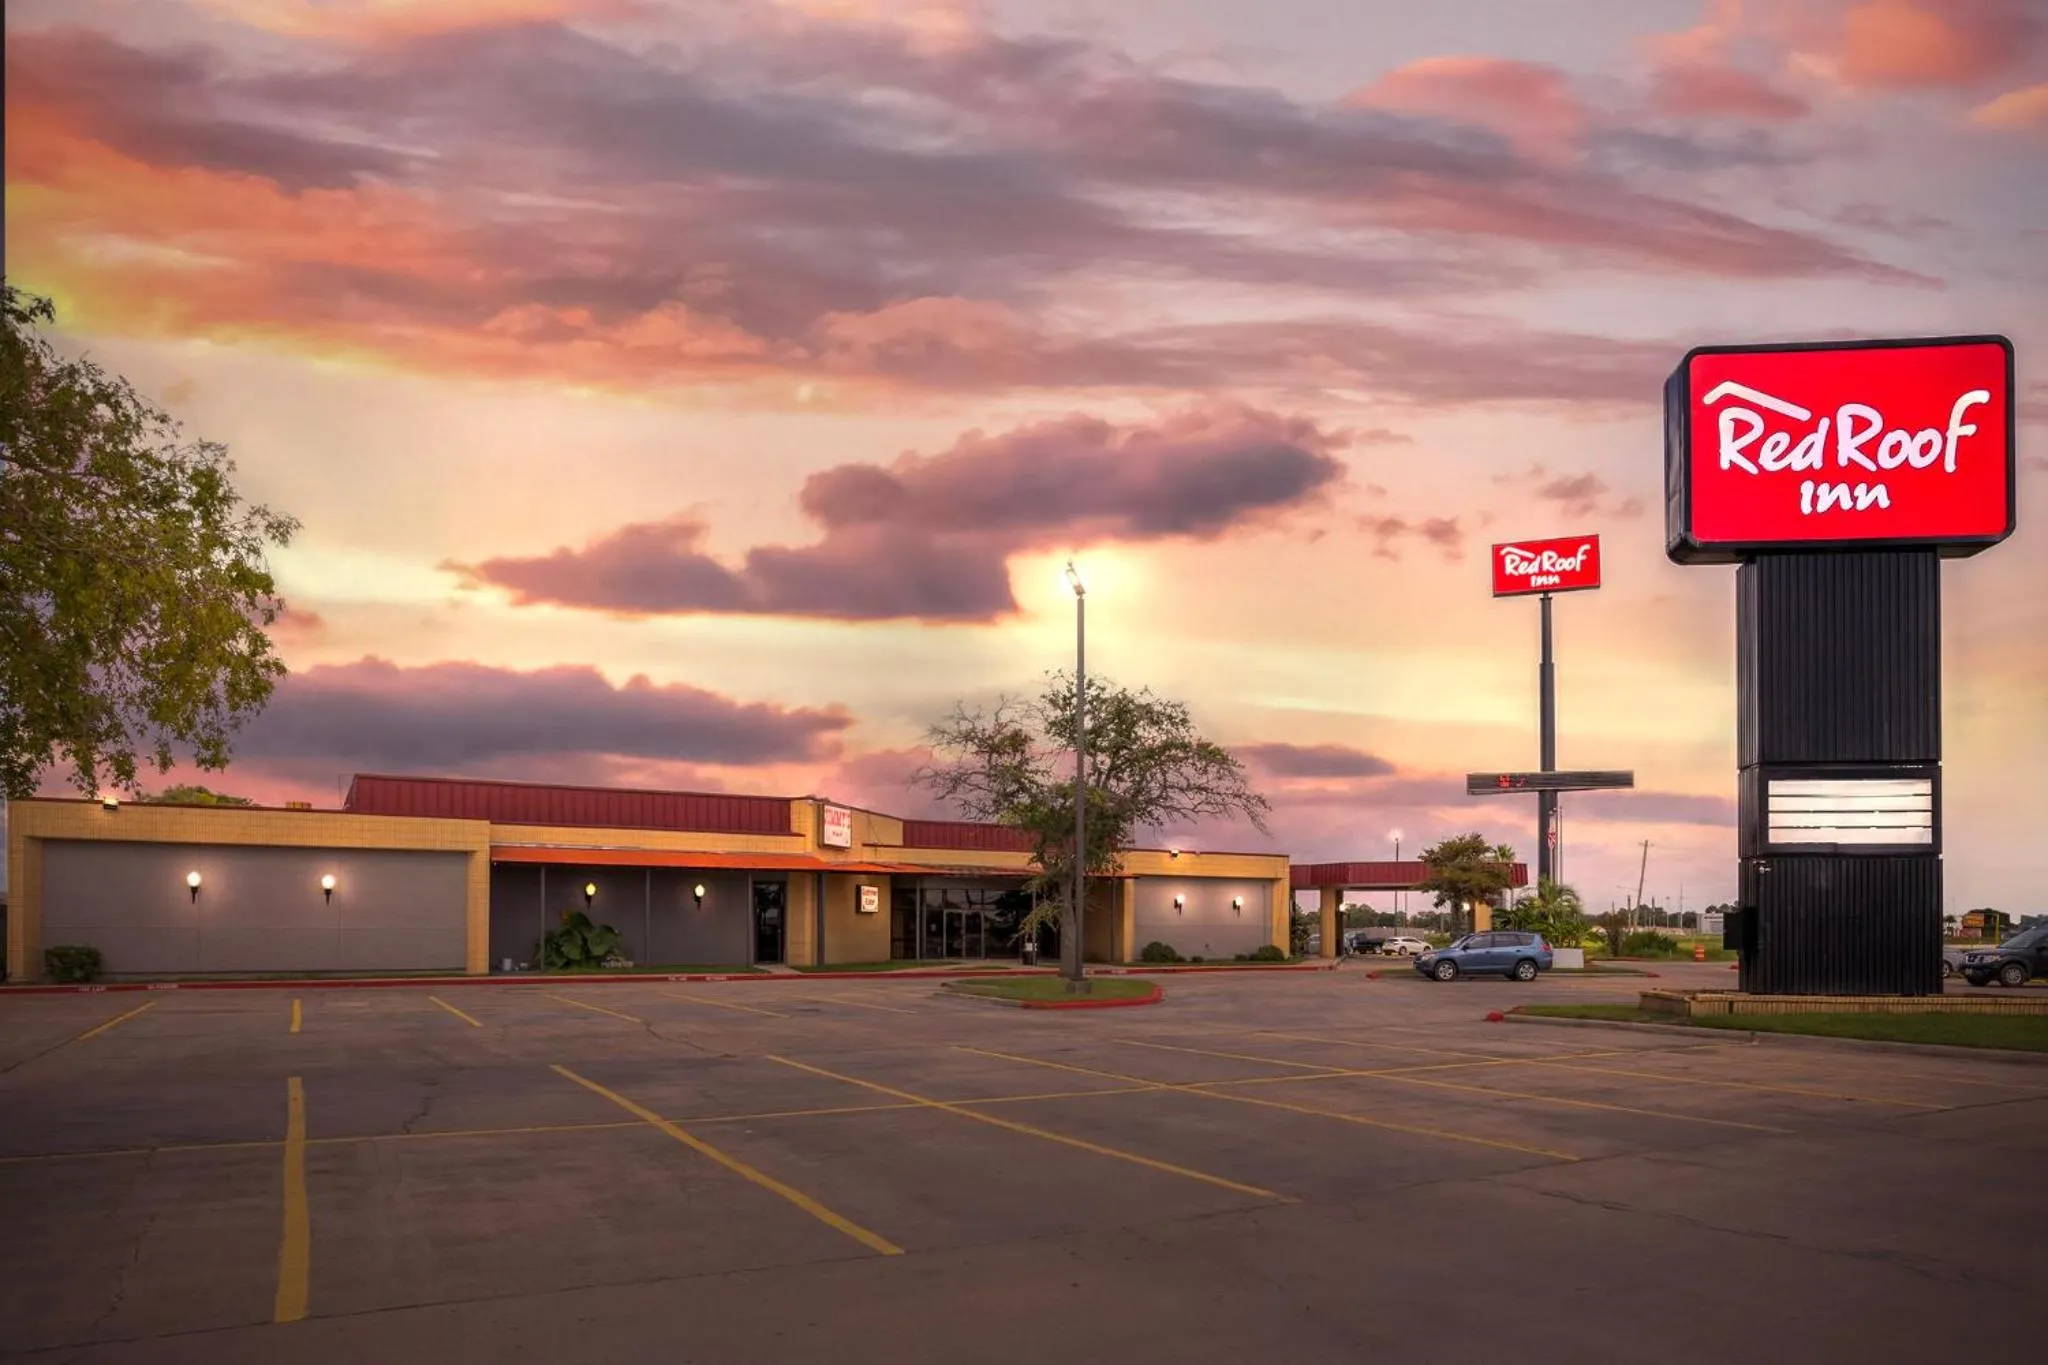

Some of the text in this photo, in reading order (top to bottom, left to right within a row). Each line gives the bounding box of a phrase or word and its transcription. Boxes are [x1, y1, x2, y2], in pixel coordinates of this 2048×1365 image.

[1718, 389, 1990, 475] Red Roof
[1504, 544, 1591, 576] Red Roof
